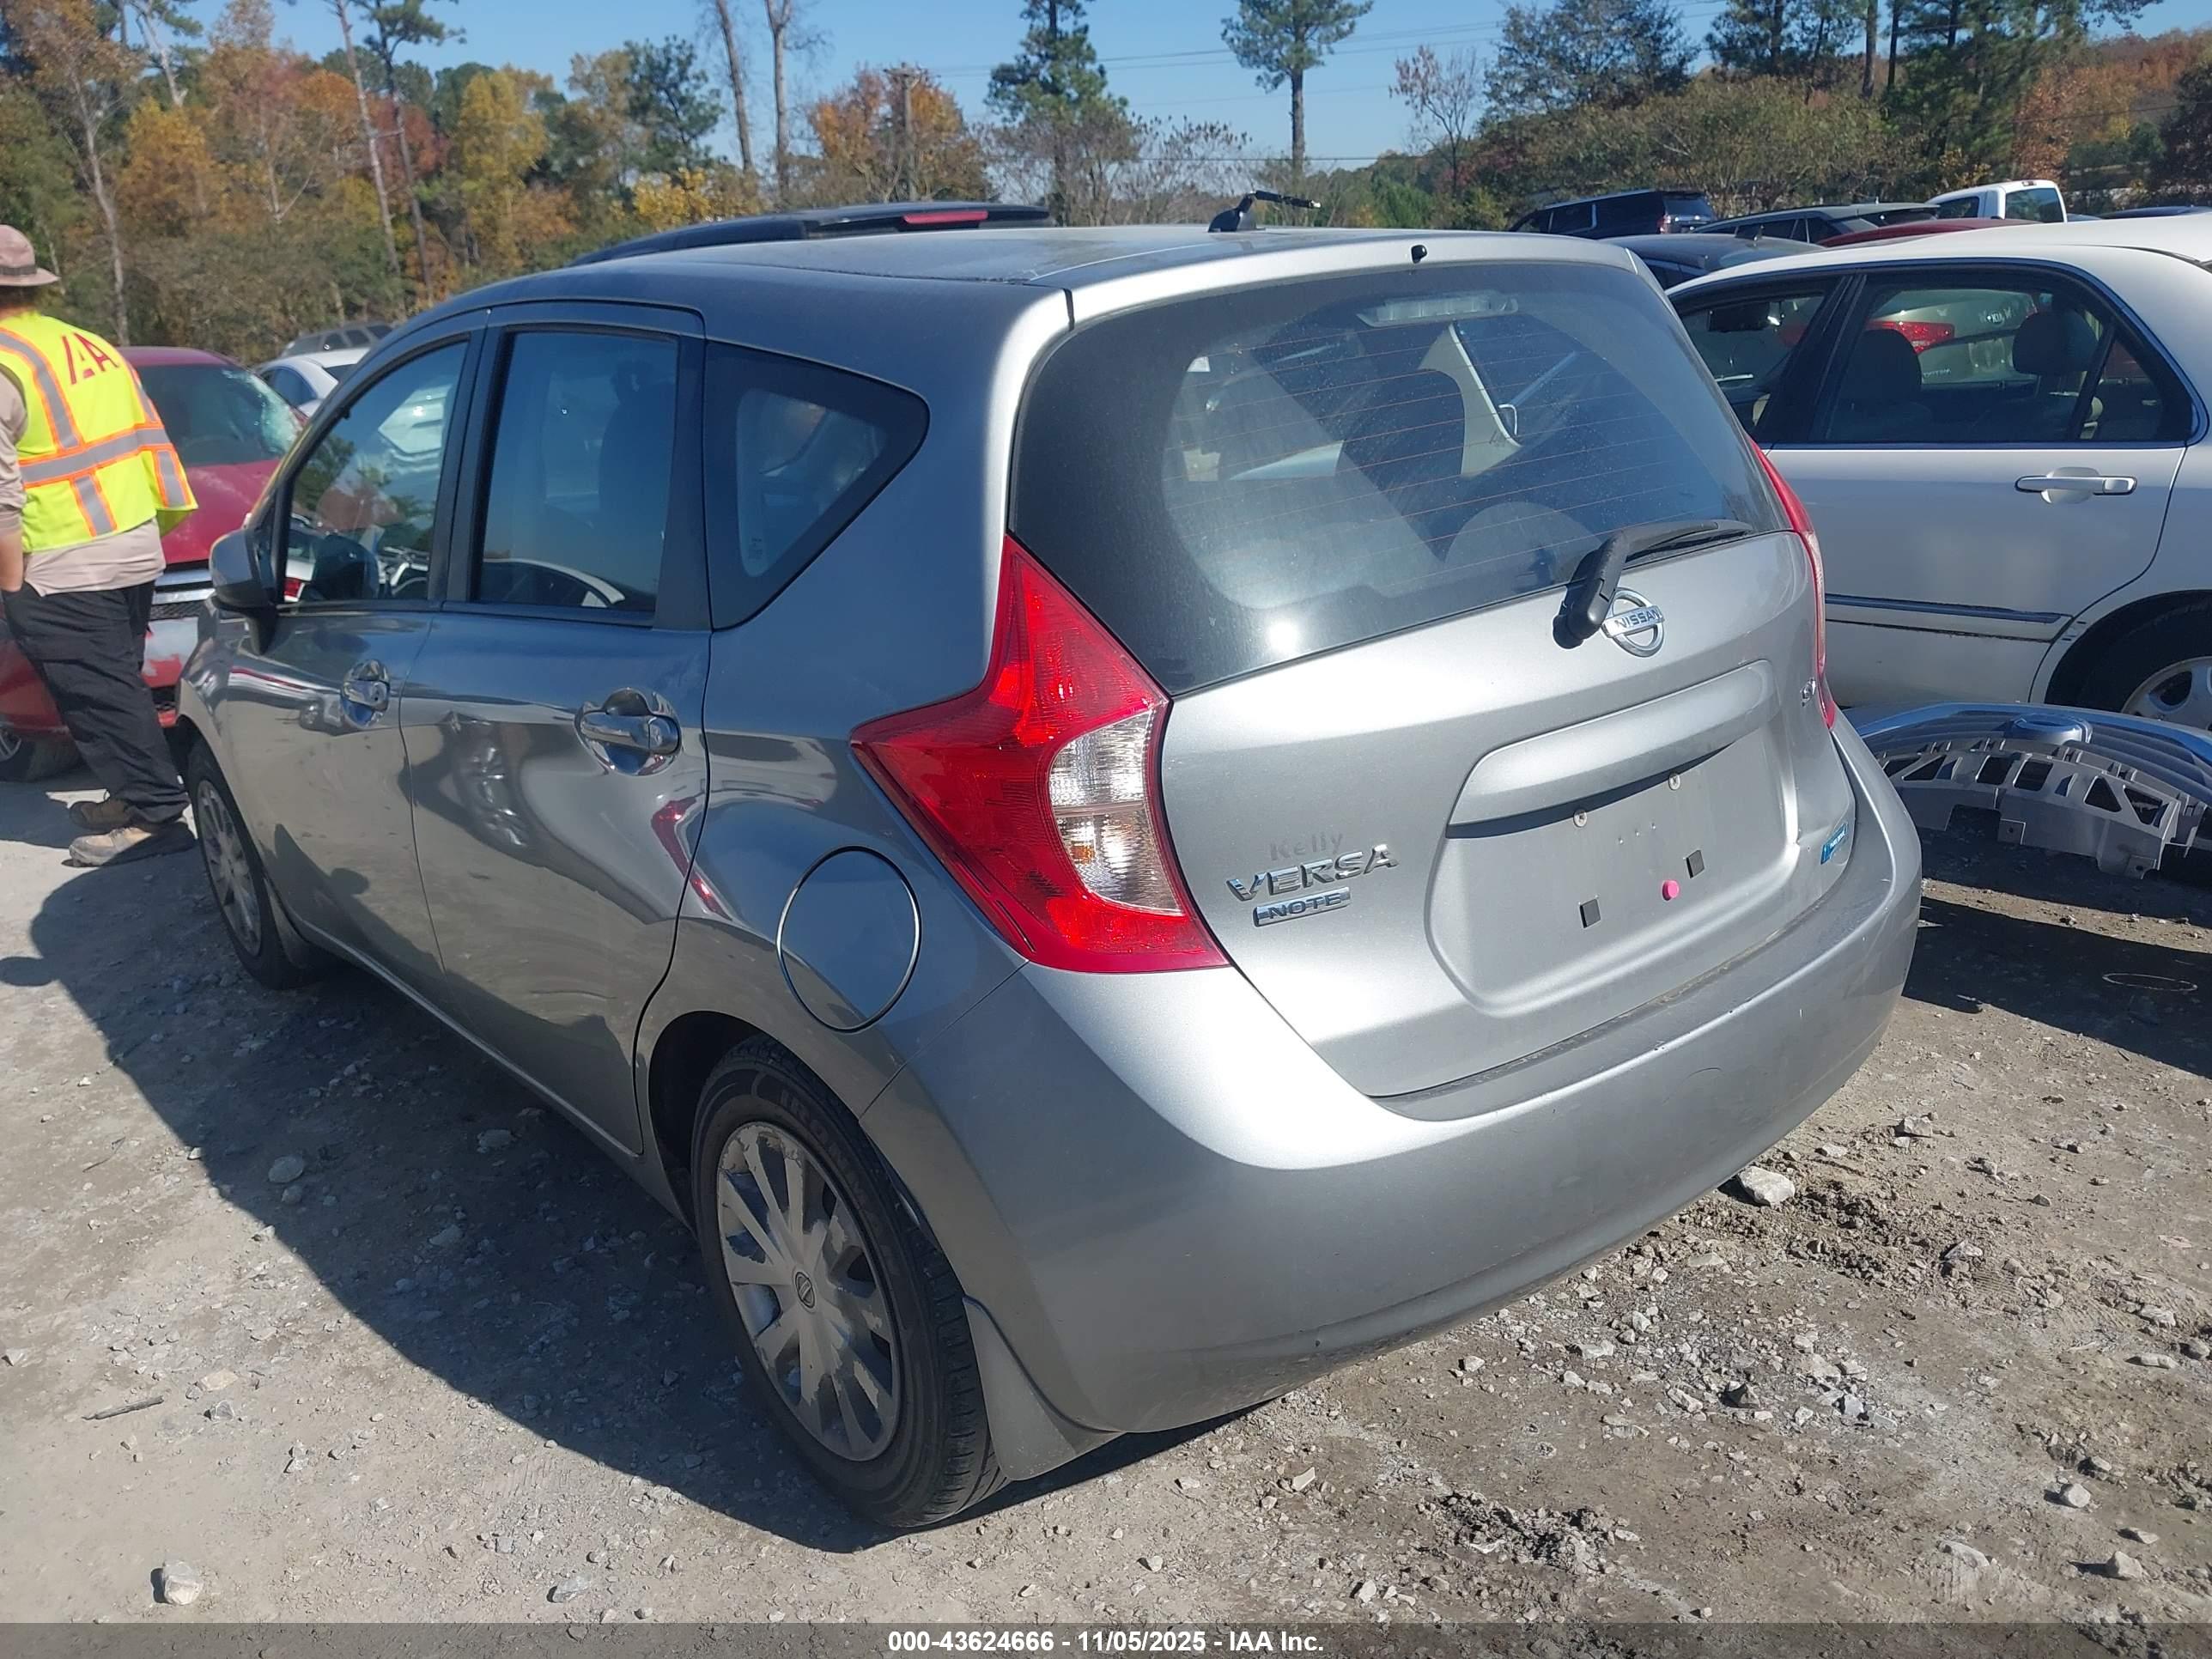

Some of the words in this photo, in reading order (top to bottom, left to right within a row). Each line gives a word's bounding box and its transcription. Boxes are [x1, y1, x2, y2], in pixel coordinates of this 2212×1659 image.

[62, 333, 119, 385] IAA
[1614, 609, 1662, 629] NISSAN
[1269, 832, 1344, 861] Kelly
[1225, 844, 1399, 902] VERSA
[1267, 892, 1342, 919] NOTE
